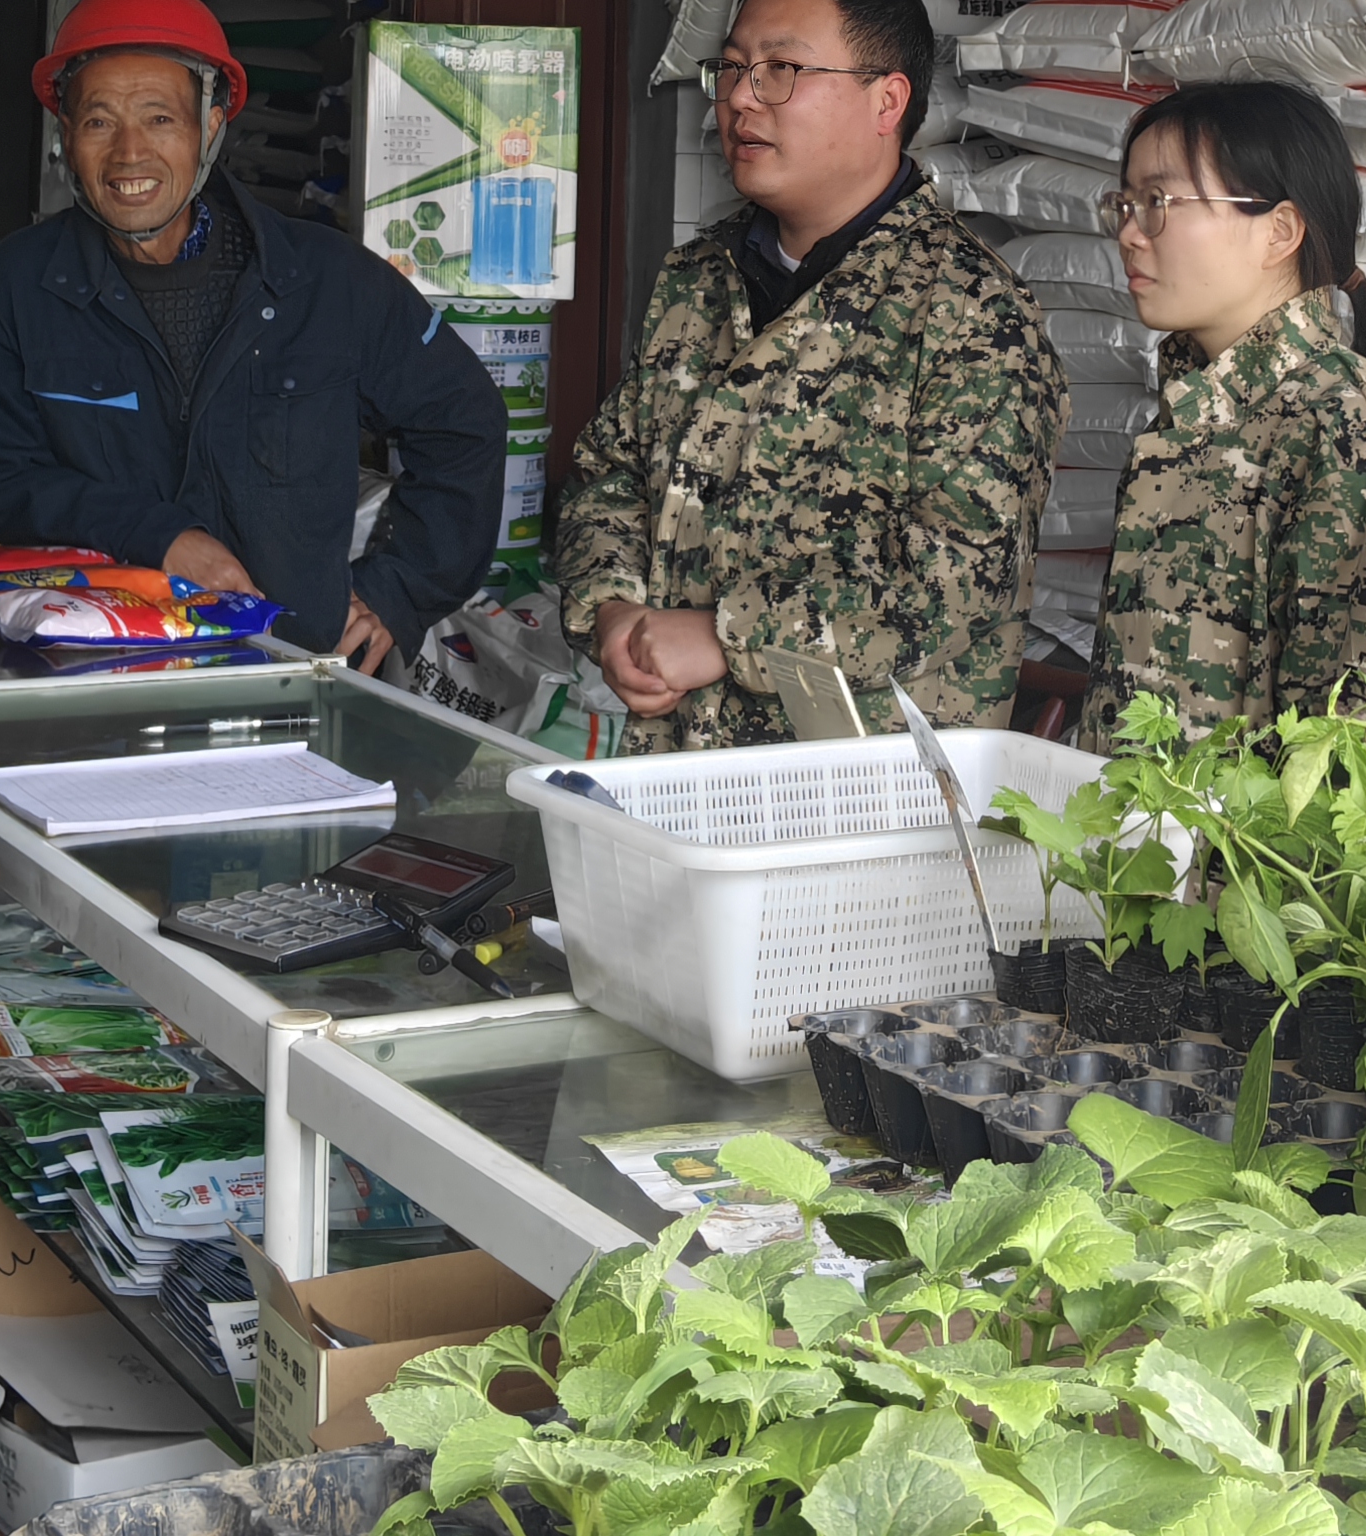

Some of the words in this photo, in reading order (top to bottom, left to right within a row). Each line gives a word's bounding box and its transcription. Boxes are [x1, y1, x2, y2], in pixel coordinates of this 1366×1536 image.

[444, 49, 565, 75] 电动喷雾器
